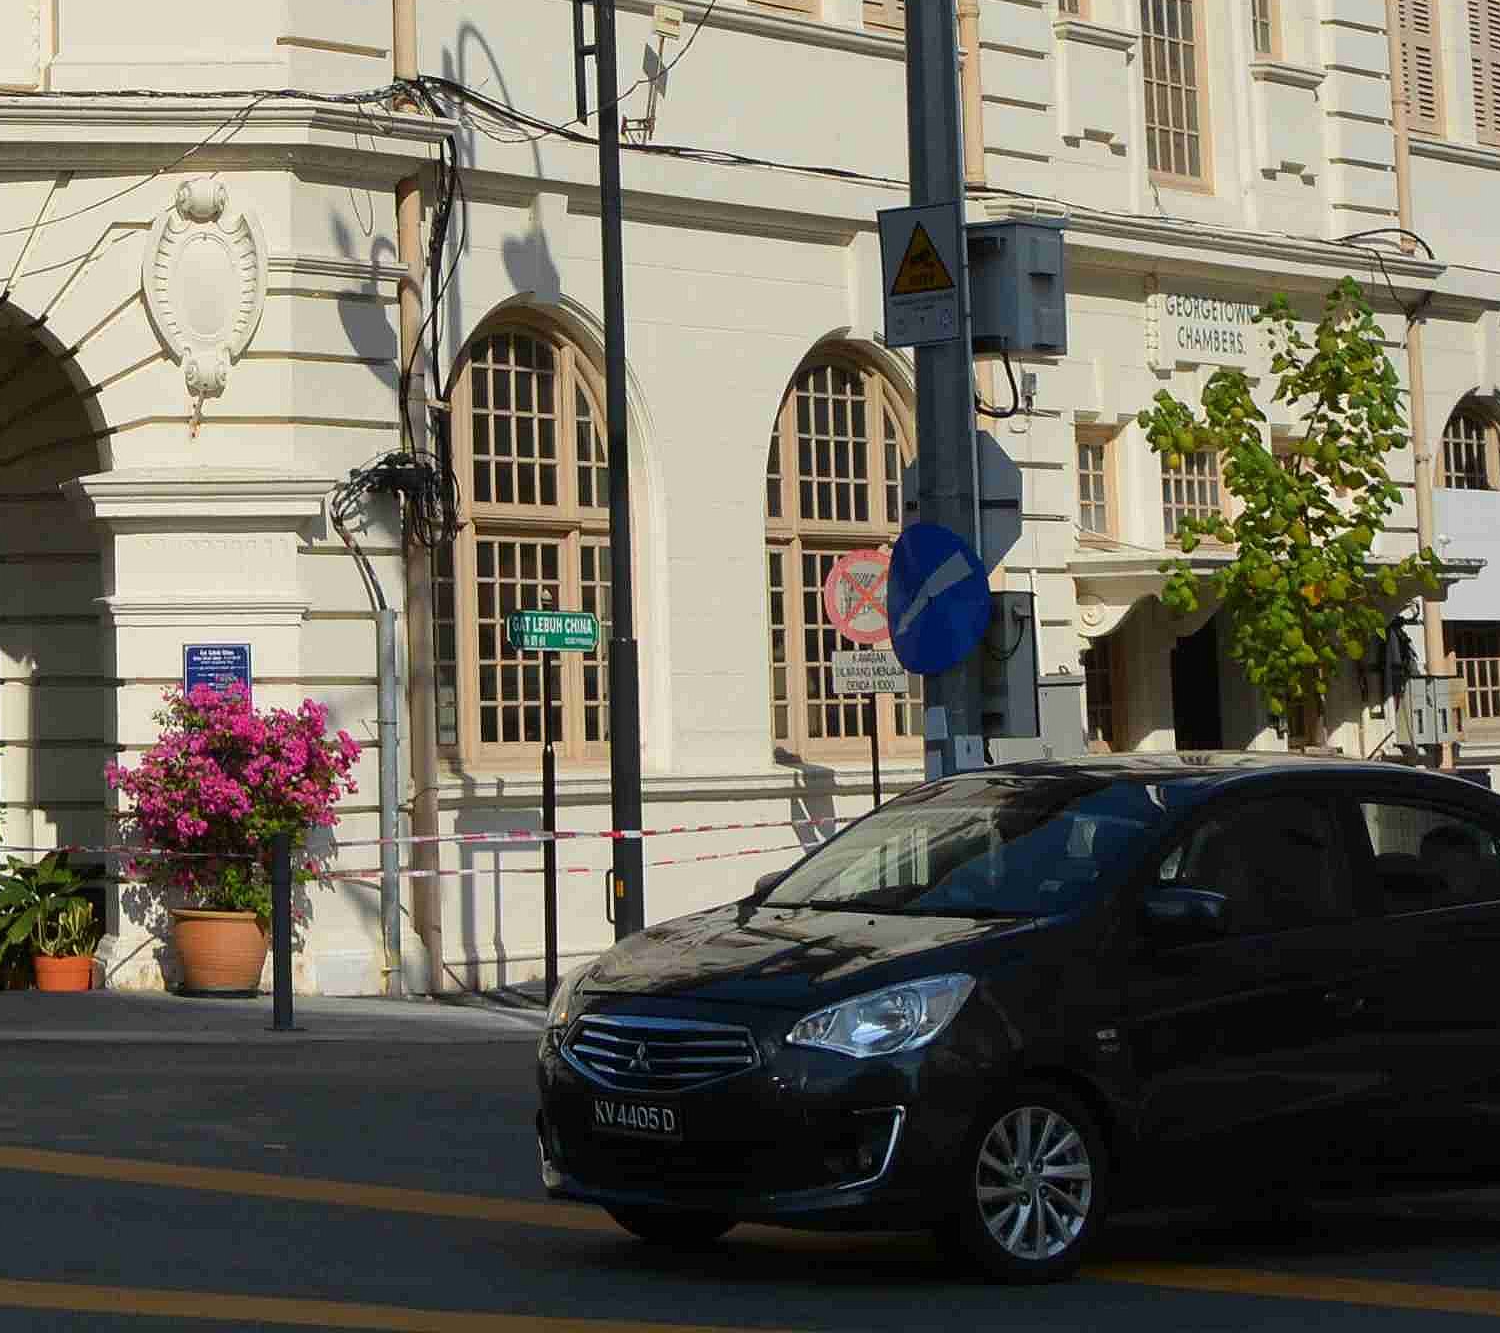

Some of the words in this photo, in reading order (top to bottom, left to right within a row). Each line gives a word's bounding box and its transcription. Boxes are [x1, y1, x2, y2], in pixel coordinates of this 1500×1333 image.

[1166, 294, 1259, 325] GEORGETOWN
[512, 616, 531, 632] GAT
[532, 616, 562, 633] LEBUH
[564, 617, 593, 634] CHINA
